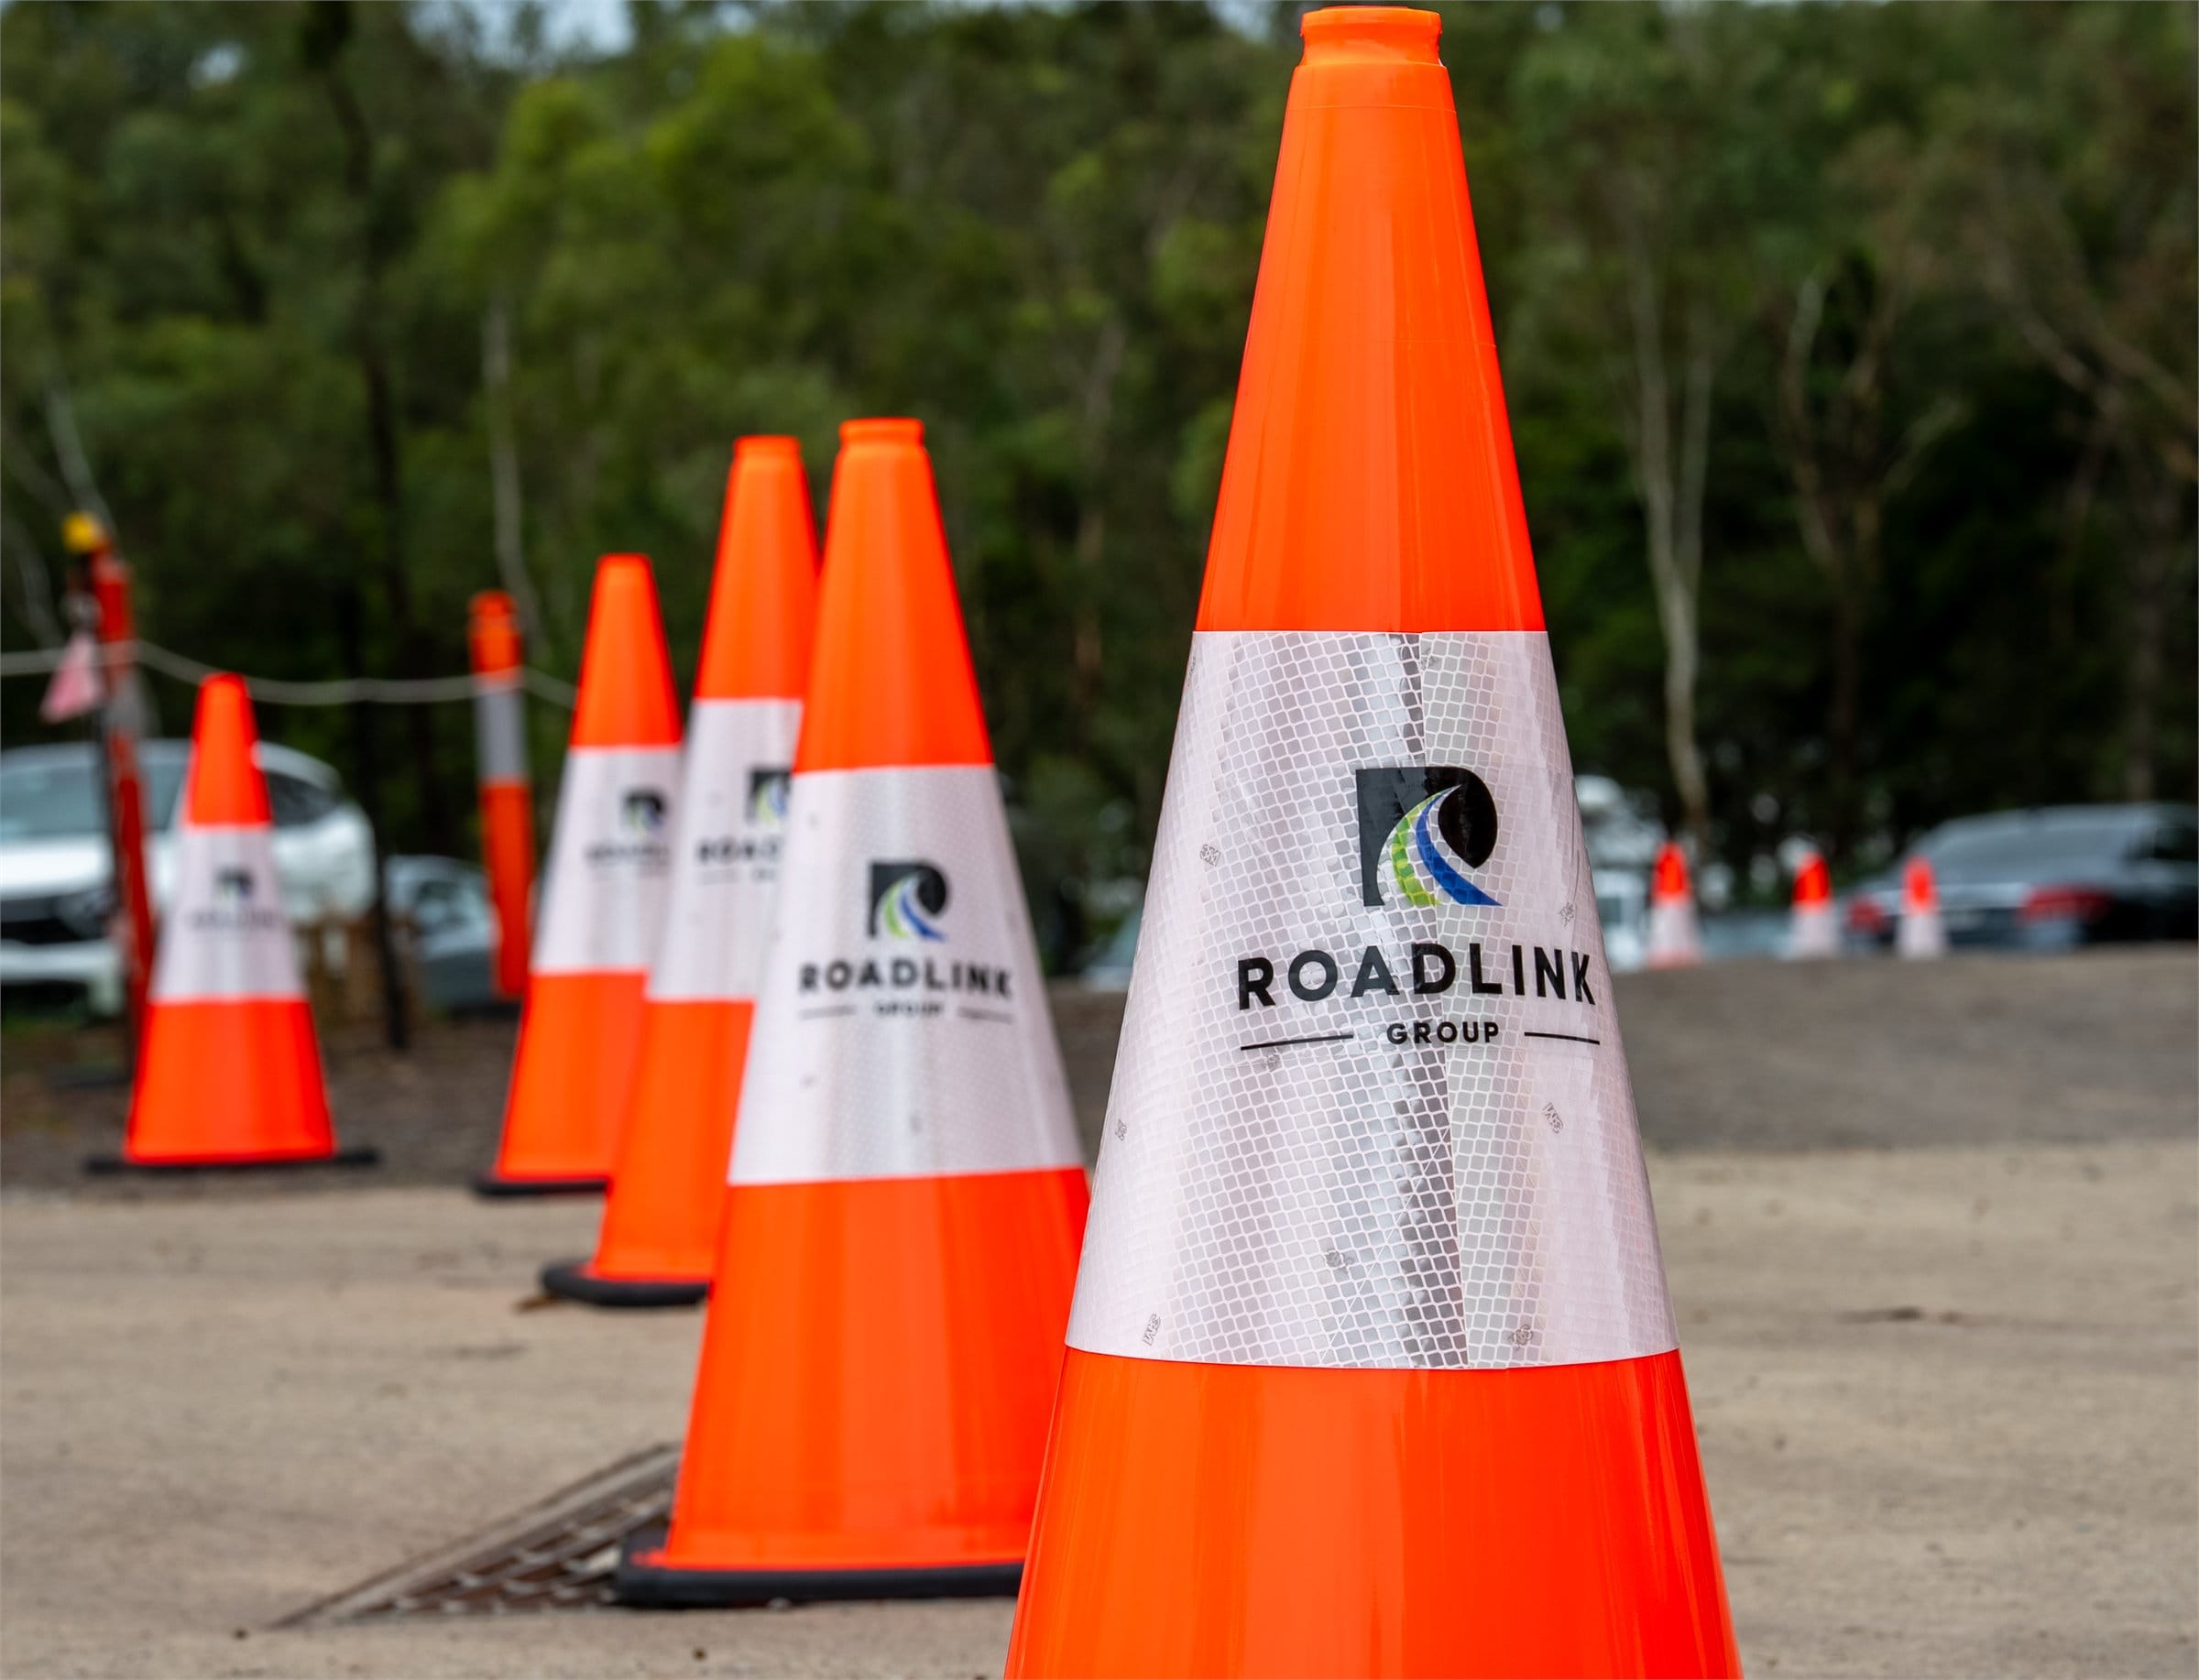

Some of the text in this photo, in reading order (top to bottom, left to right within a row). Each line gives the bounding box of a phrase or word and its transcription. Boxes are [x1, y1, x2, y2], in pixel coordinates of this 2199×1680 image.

[799, 957, 1012, 998] ROADLINK
[1238, 943, 1596, 1010] ROADLINK
[1386, 1021, 1499, 1044] GROUP
